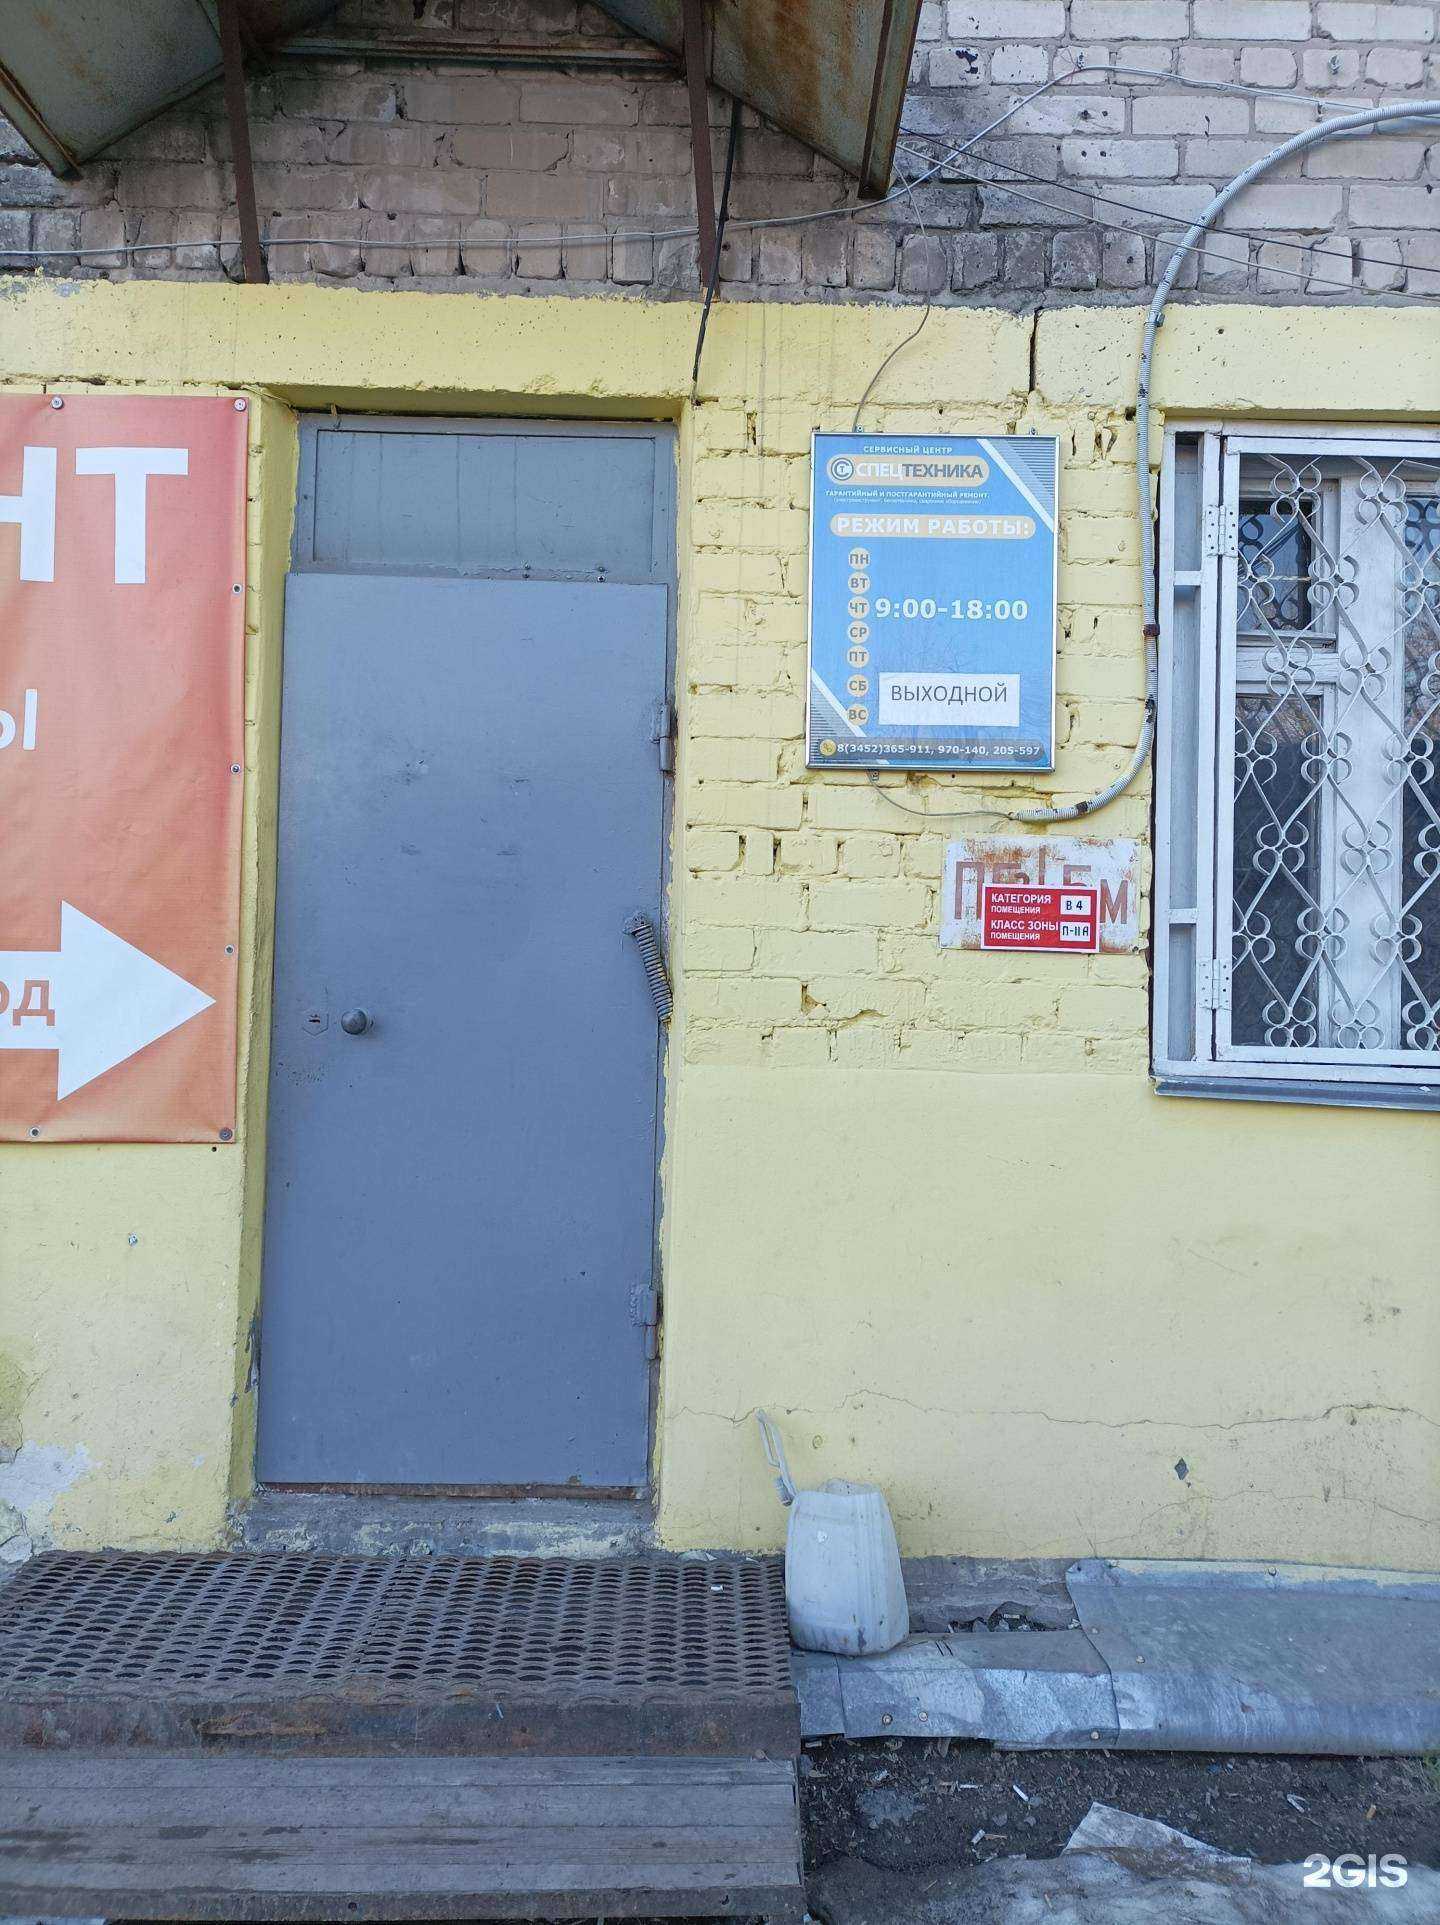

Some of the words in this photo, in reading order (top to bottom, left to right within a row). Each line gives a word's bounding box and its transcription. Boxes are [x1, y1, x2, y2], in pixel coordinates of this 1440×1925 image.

[863, 445, 920, 454] СЕРВИСНЫЙ
[922, 446, 953, 455] ЦЕНТР
[855, 462, 984, 480] СПЕЦТЕХНИКА
[825, 489, 878, 497] ГАРАНТИЙНЫЙ
[837, 517, 919, 534] РЕЖИМ
[928, 519, 1030, 536] РАБОТЫ:
[849, 554, 870, 565] ПН
[850, 578, 868, 588] ВТ
[849, 603, 867, 613] ЧТ
[875, 598, 1028, 620] 9:00-18:00
[849, 627, 867, 638] СР
[849, 652, 867, 662] ПТ
[849, 680, 867, 691] СБ
[891, 682, 1008, 706] ВЫХОДНОЙ
[848, 709, 867, 720] ВС
[991, 893, 1052, 904] КАТЕГОРИЯ
[991, 905, 1041, 914] ПОМЕЩЕНИЯ
[990, 919, 1025, 930] КЛАСС
[1027, 921, 1059, 931] ЗОНЫ
[990, 931, 1041, 941] ПОМЕЩЕНИЯ
